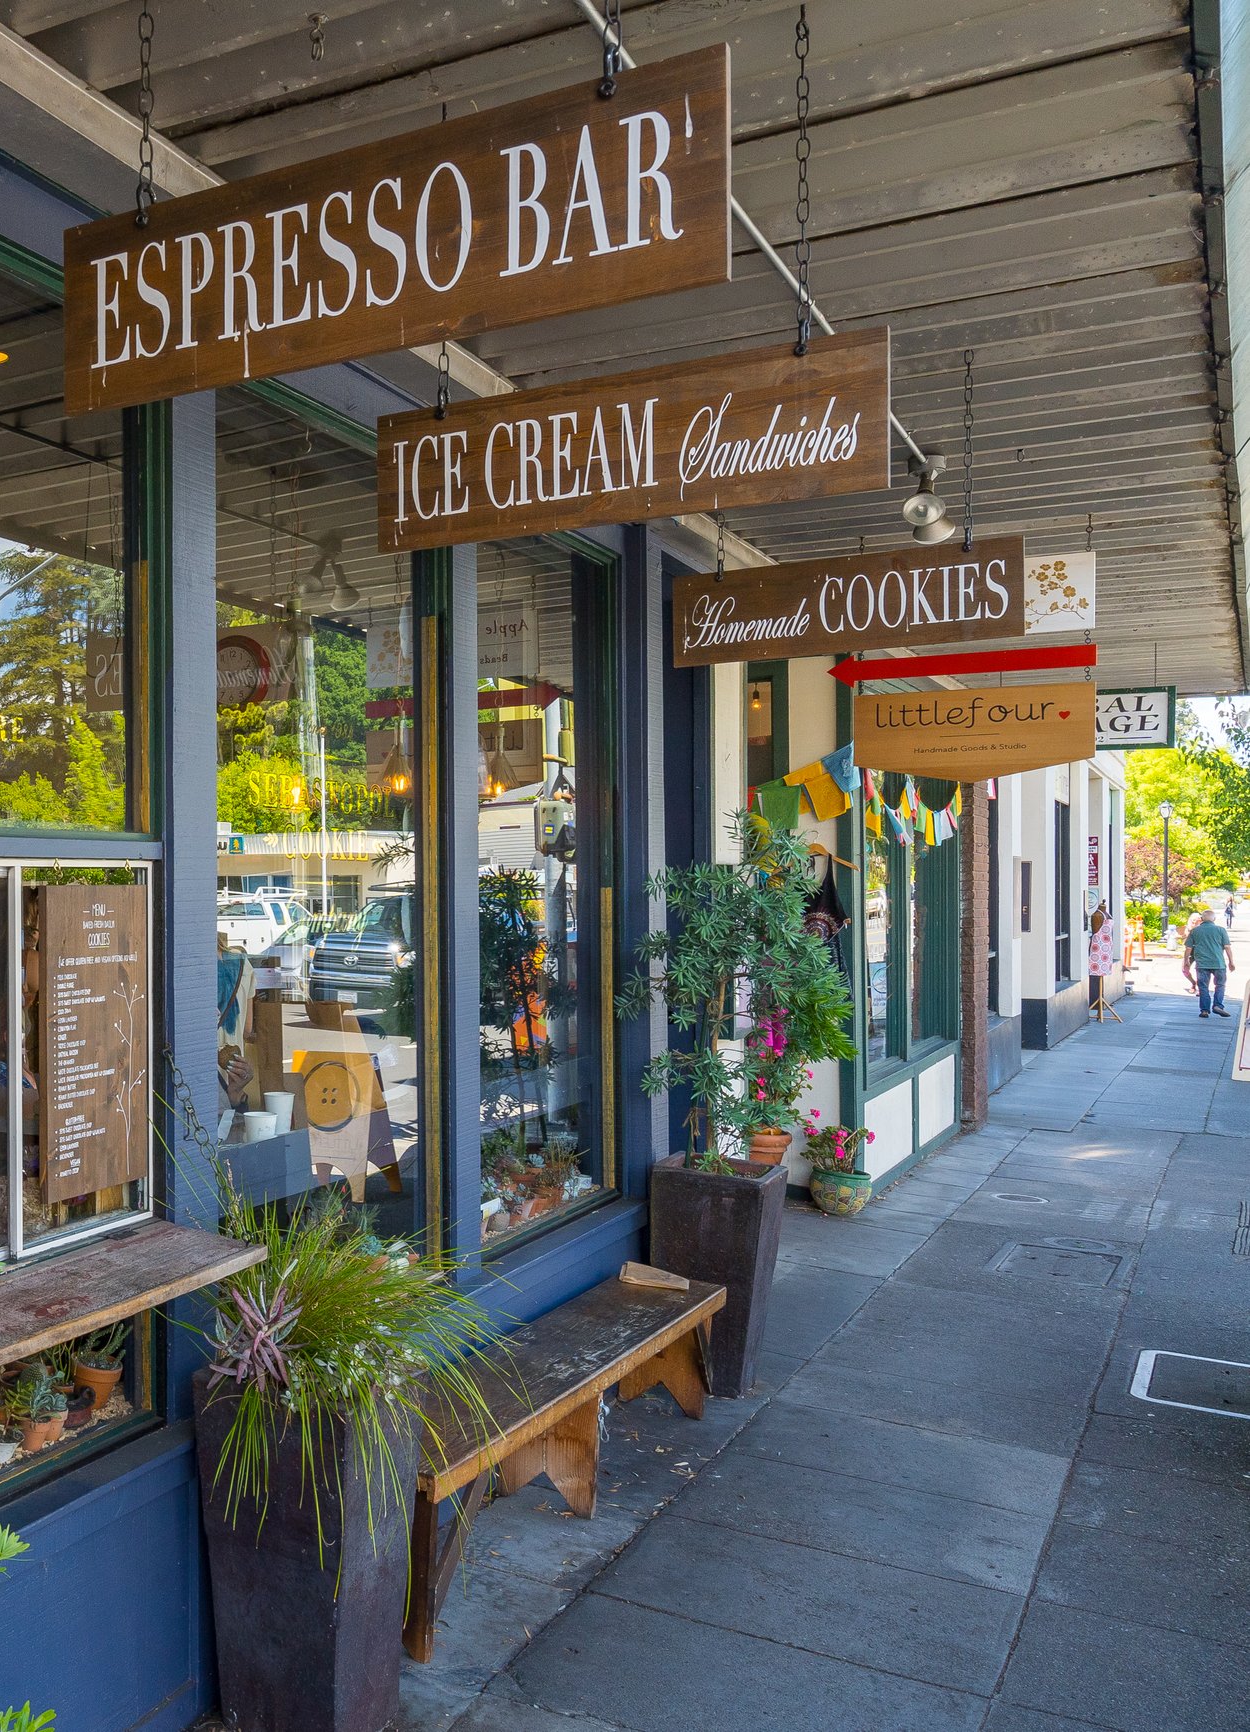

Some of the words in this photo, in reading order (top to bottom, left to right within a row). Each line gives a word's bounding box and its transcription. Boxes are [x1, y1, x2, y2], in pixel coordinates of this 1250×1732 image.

[90, 161, 472, 370] ESPRESSO
[499, 110, 684, 279] BAR
[393, 430, 469, 525] ICE
[484, 398, 658, 512] CREAM
[678, 392, 861, 503] Sandwiches
[686, 595, 811, 648] Homemade
[818, 559, 1009, 634] COOKIES
[875, 697, 1055, 729] littlefour
[913, 746, 958, 754] Handmade
[960, 744, 988, 752] Goods
[990, 743, 997, 751] &
[999, 742, 1027, 750] Studio
[248, 770, 395, 819] SEBASTOPOL
[282, 822, 369, 862] COOKIE
[88, 932, 110, 947] COOKIES
